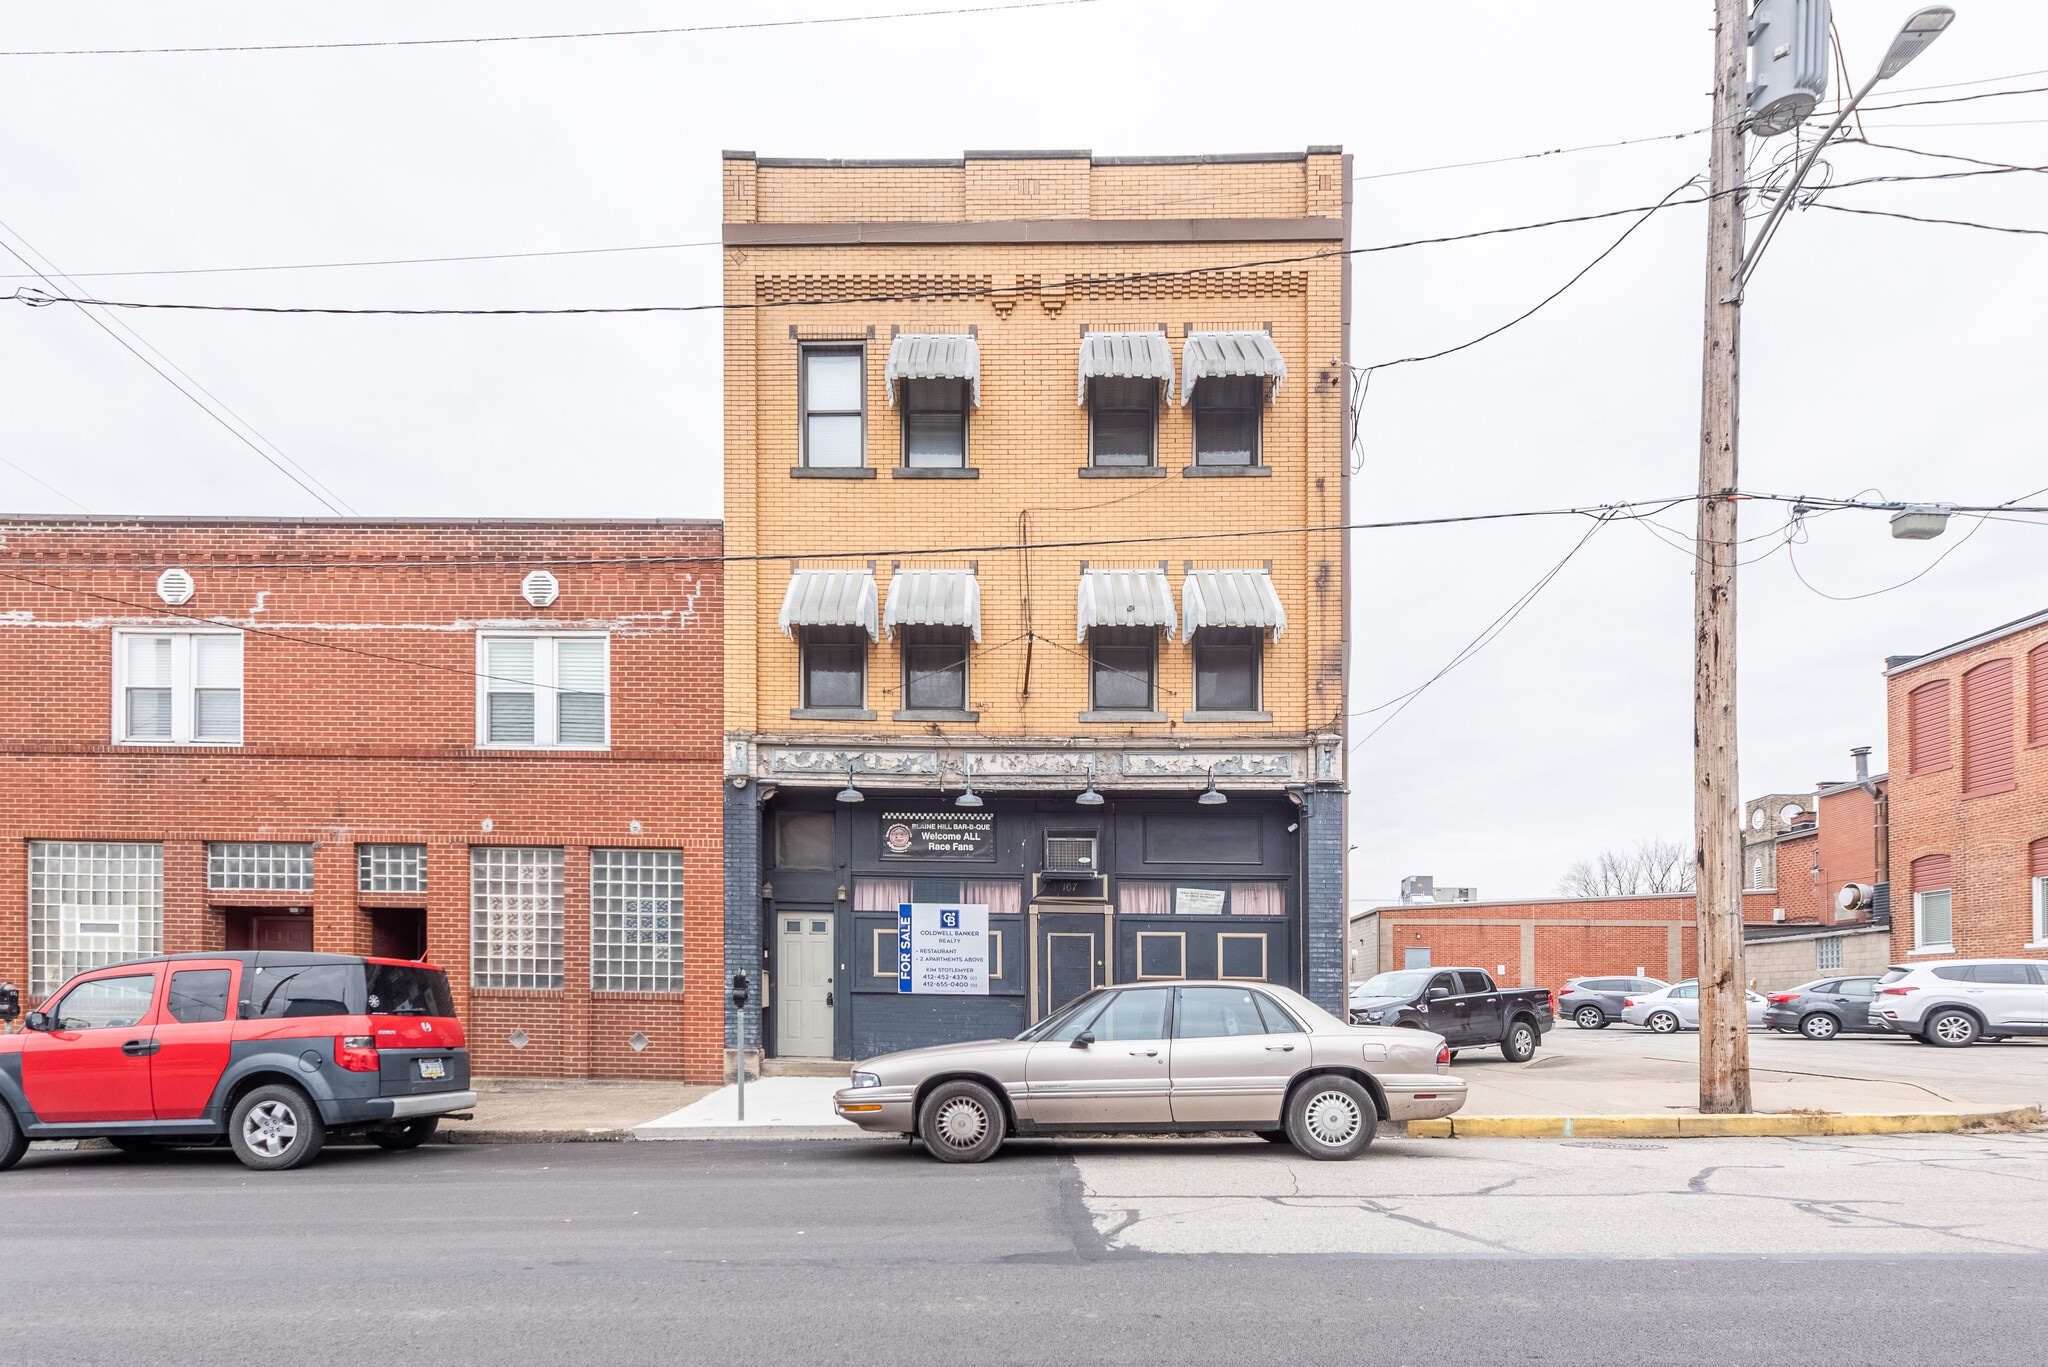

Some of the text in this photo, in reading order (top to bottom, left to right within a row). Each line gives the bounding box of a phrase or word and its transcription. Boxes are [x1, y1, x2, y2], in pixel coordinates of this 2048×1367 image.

[921, 832, 981, 841] Welcome ALL
[928, 842, 974, 851] Race Fans
[1062, 883, 1078, 892] 107
[900, 917, 911, 980] FOR SALE
